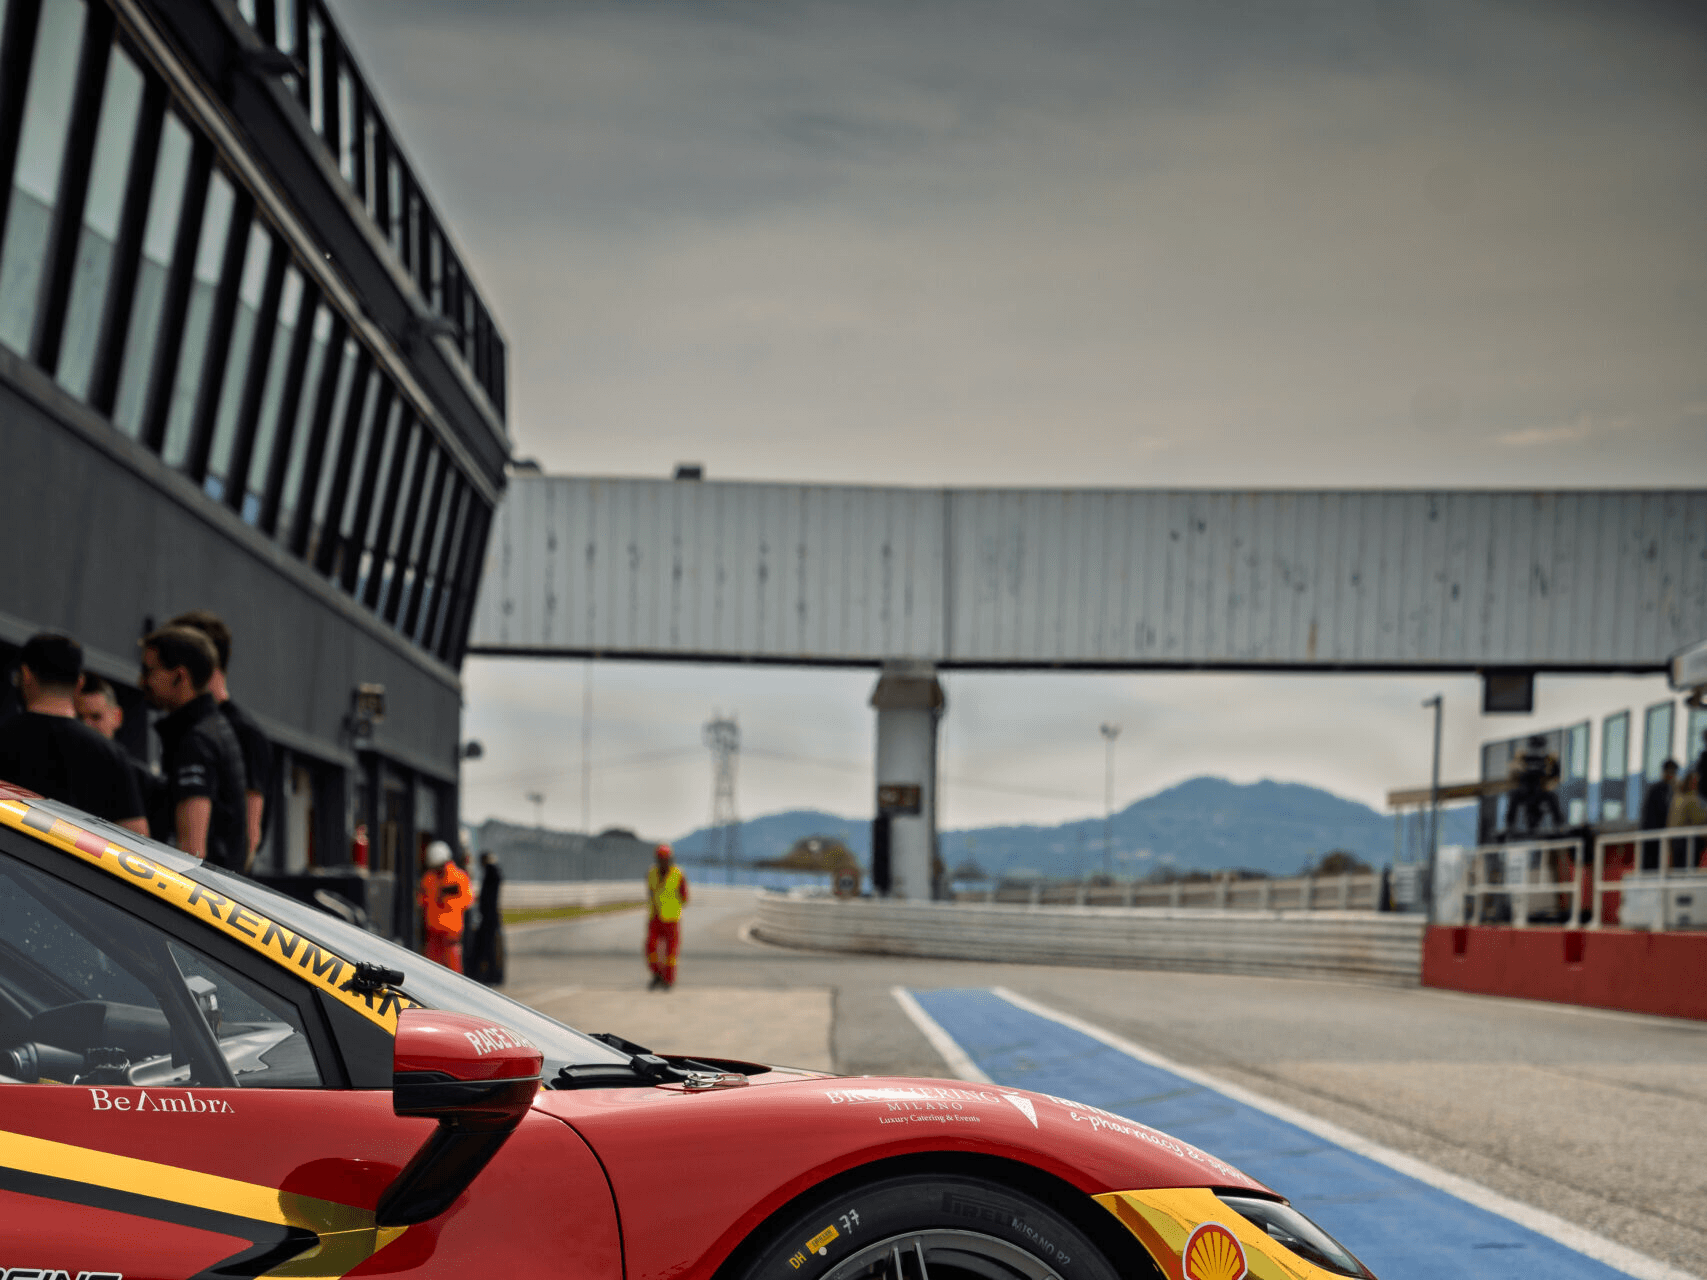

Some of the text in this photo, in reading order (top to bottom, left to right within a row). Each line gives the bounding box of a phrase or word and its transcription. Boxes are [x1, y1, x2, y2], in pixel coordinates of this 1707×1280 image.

[118, 851, 166, 889] G.
[90, 1089, 131, 1111] Be
[887, 1101, 963, 1111] MILANO
[879, 1114, 909, 1124] Luxury
[910, 1113, 945, 1123] Catering
[955, 1114, 980, 1123] Events
[1070, 1111, 1184, 1157] e-pharmacy
[839, 1208, 860, 1235] 77
[1011, 1218, 1072, 1266] MISANO R2
[789, 1251, 807, 1269] DH
